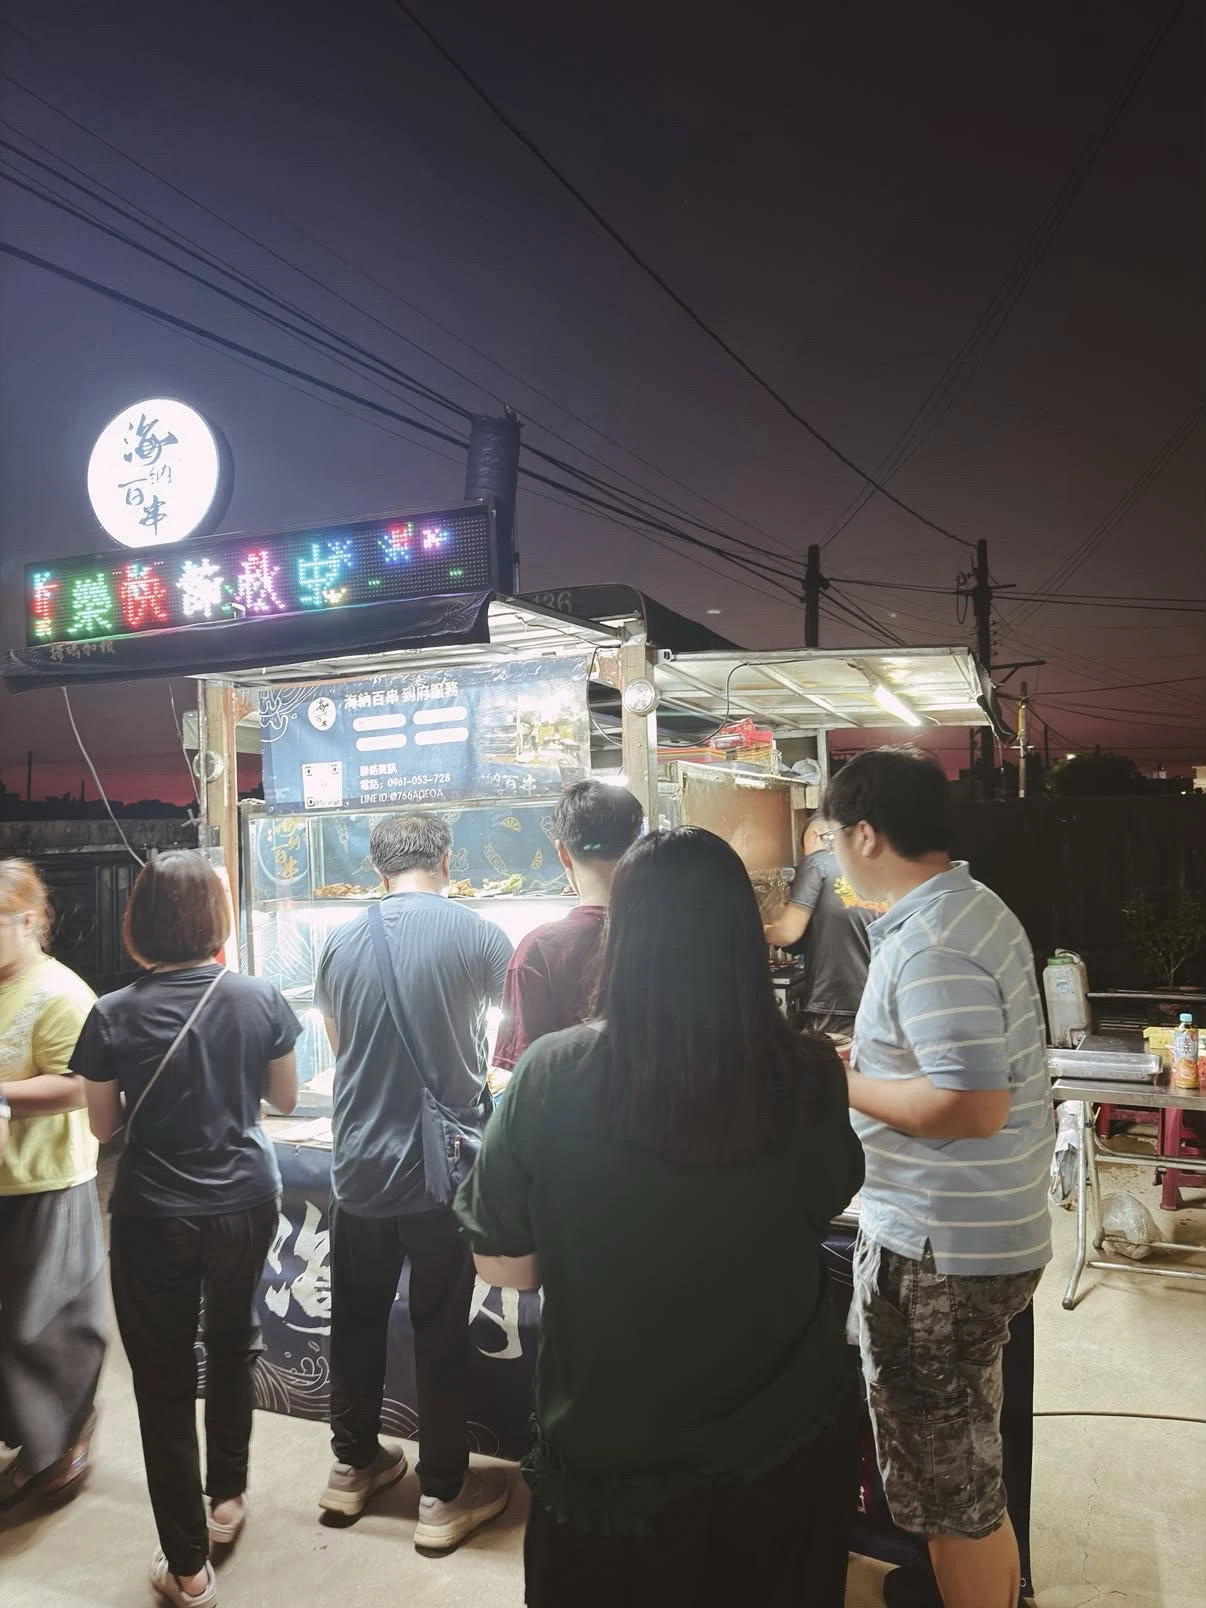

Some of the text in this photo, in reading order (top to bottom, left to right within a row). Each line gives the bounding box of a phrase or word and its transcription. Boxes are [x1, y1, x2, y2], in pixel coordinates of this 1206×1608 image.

[118, 413, 179, 536] 海納百串
[344, 689, 399, 709] 海納百串
[387, 773, 451, 788] 0961-053-728
